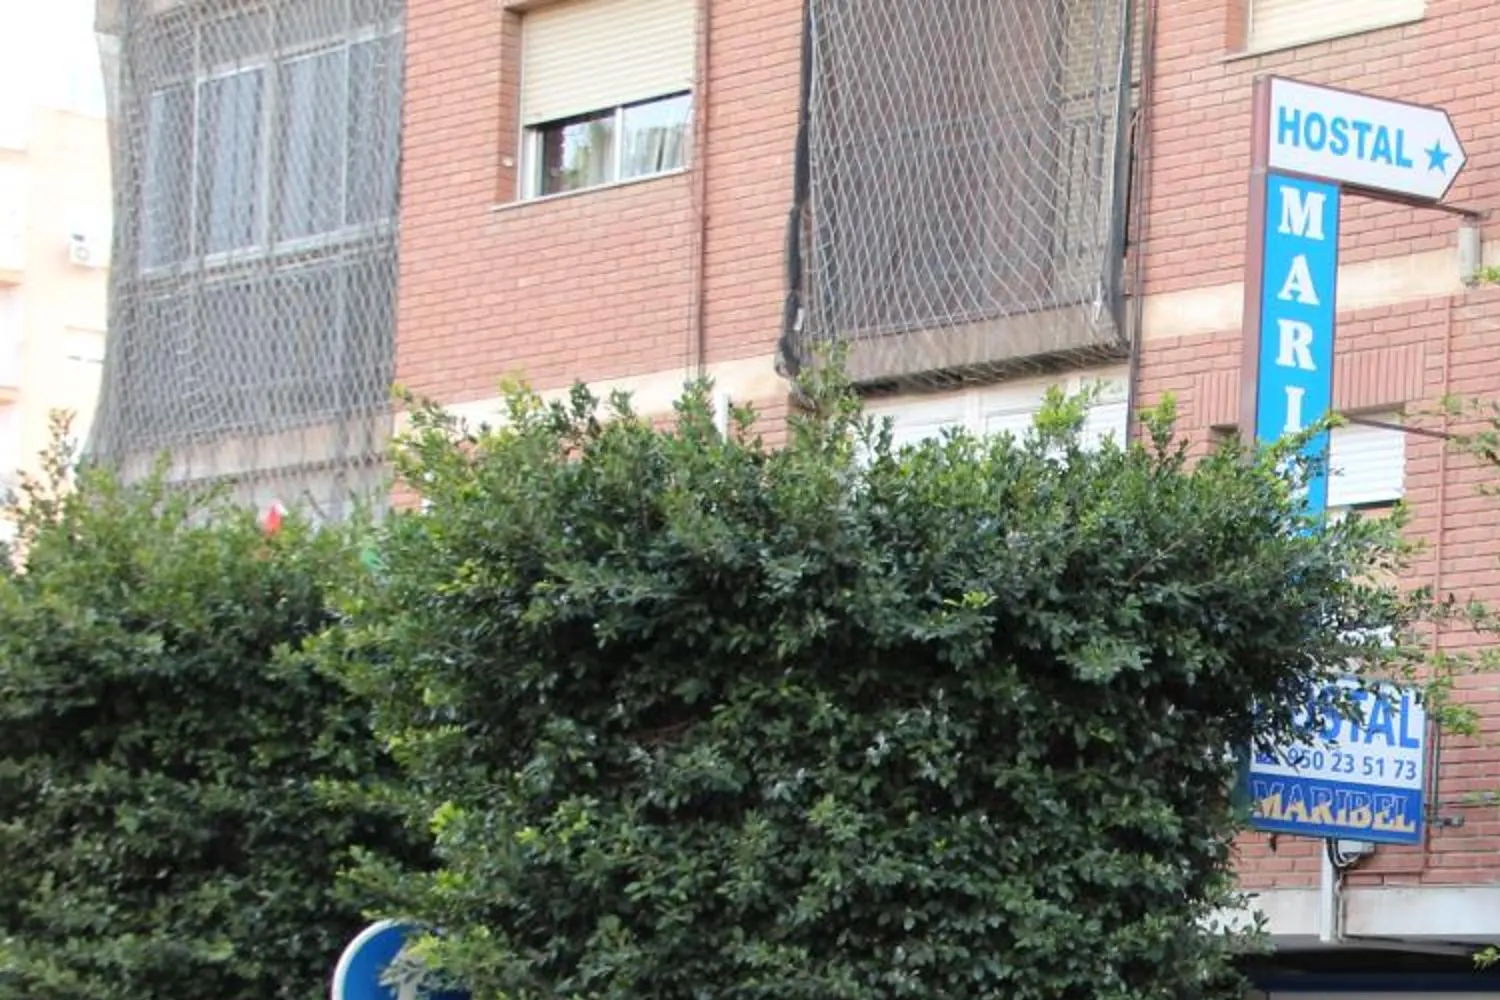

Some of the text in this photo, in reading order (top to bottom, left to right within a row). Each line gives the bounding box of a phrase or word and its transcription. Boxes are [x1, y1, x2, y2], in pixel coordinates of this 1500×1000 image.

[1276, 105, 1414, 170] HOSTAL
[1287, 748, 1418, 781] 950 23 51 73
[1253, 780, 1416, 832] MARIBEL
